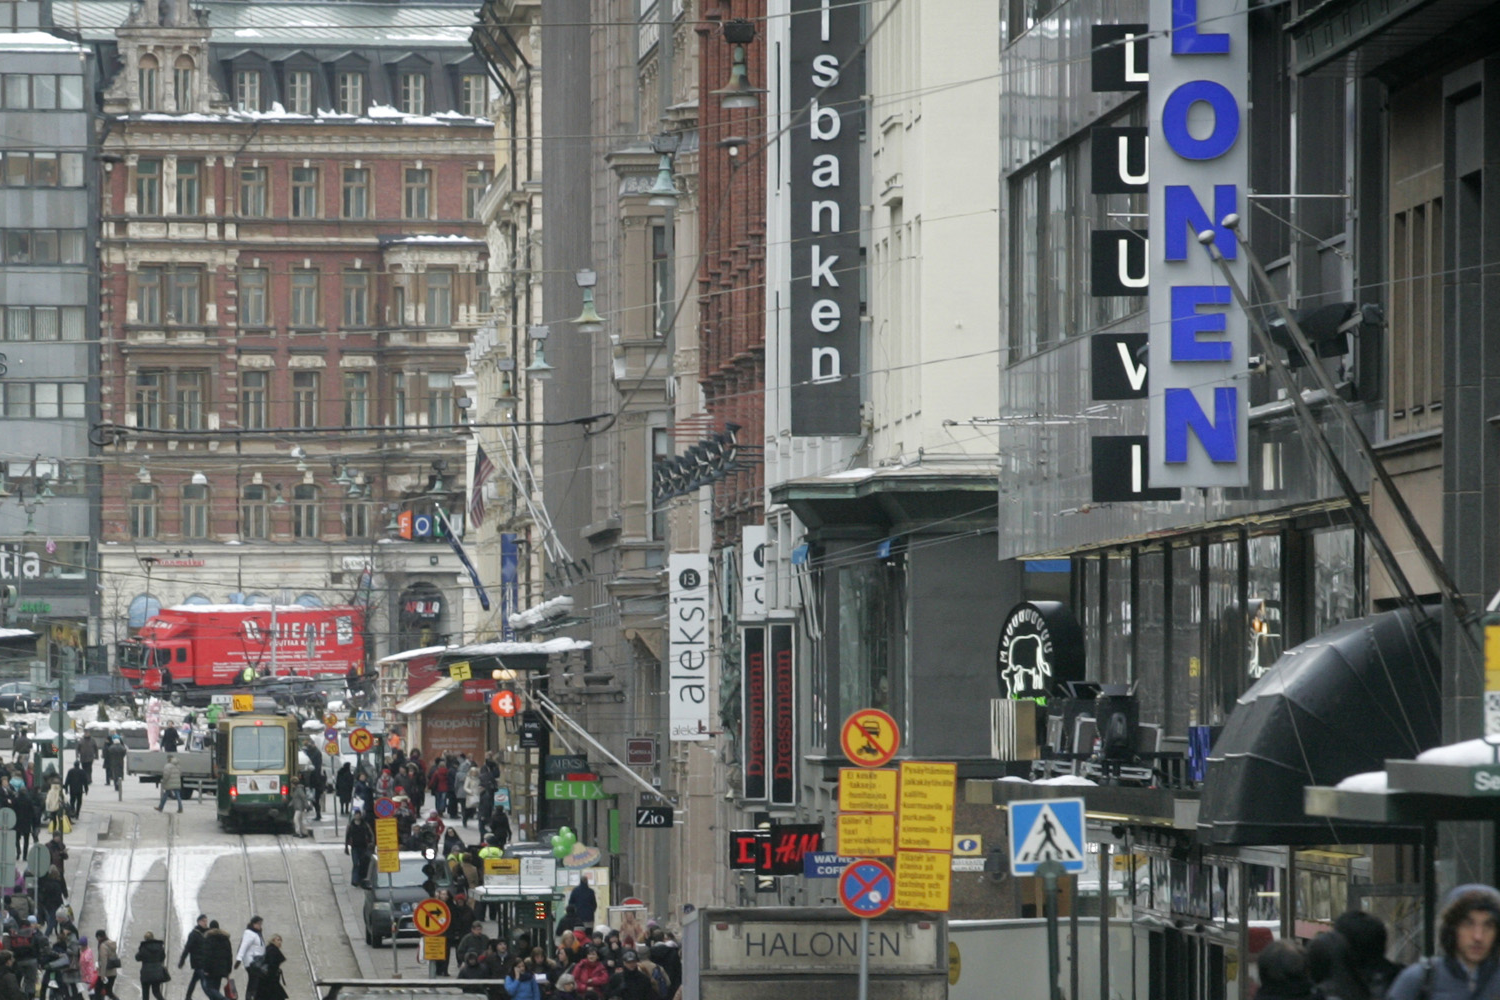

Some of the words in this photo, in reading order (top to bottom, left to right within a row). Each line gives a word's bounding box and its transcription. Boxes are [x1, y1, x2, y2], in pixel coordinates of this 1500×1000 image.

[670, 596, 705, 704] aleksi
[672, 724, 701, 736] aleks
[748, 653, 764, 777] Dressmann
[775, 650, 792, 780] Dressmann
[638, 810, 665, 825] Zio
